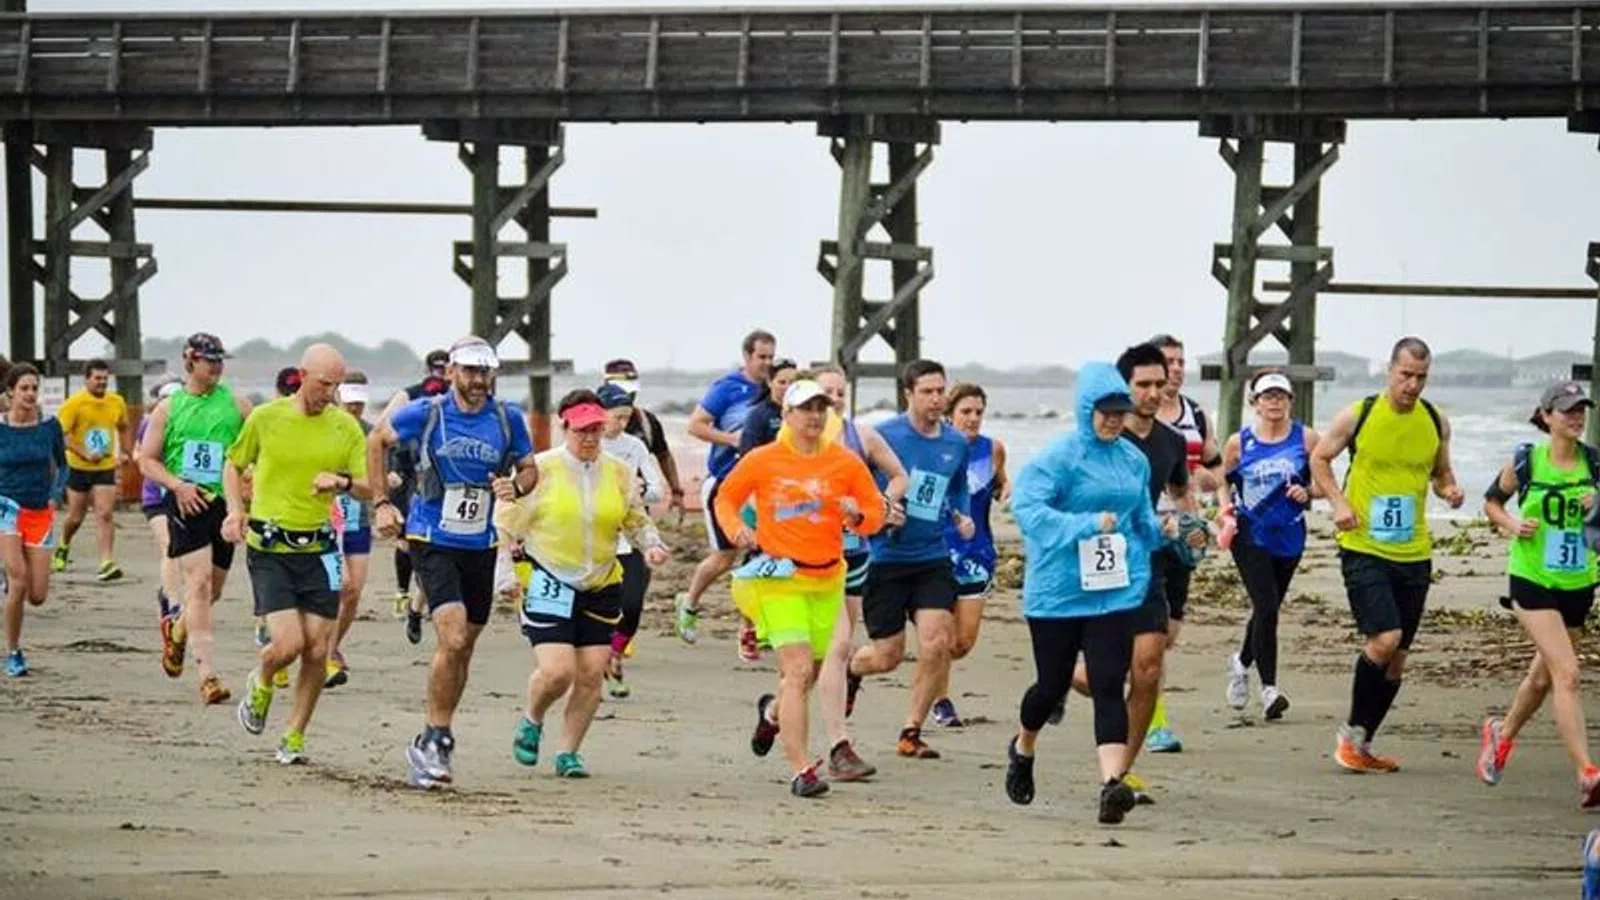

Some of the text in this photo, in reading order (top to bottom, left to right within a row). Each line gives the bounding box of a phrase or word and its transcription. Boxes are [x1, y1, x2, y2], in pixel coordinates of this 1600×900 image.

[193, 452, 211, 469] 58
[456, 500, 480, 519] 49
[1384, 509, 1402, 527] 61
[1095, 549, 1116, 571] 23
[1558, 543, 1578, 565] 31
[541, 578, 561, 599] 33
